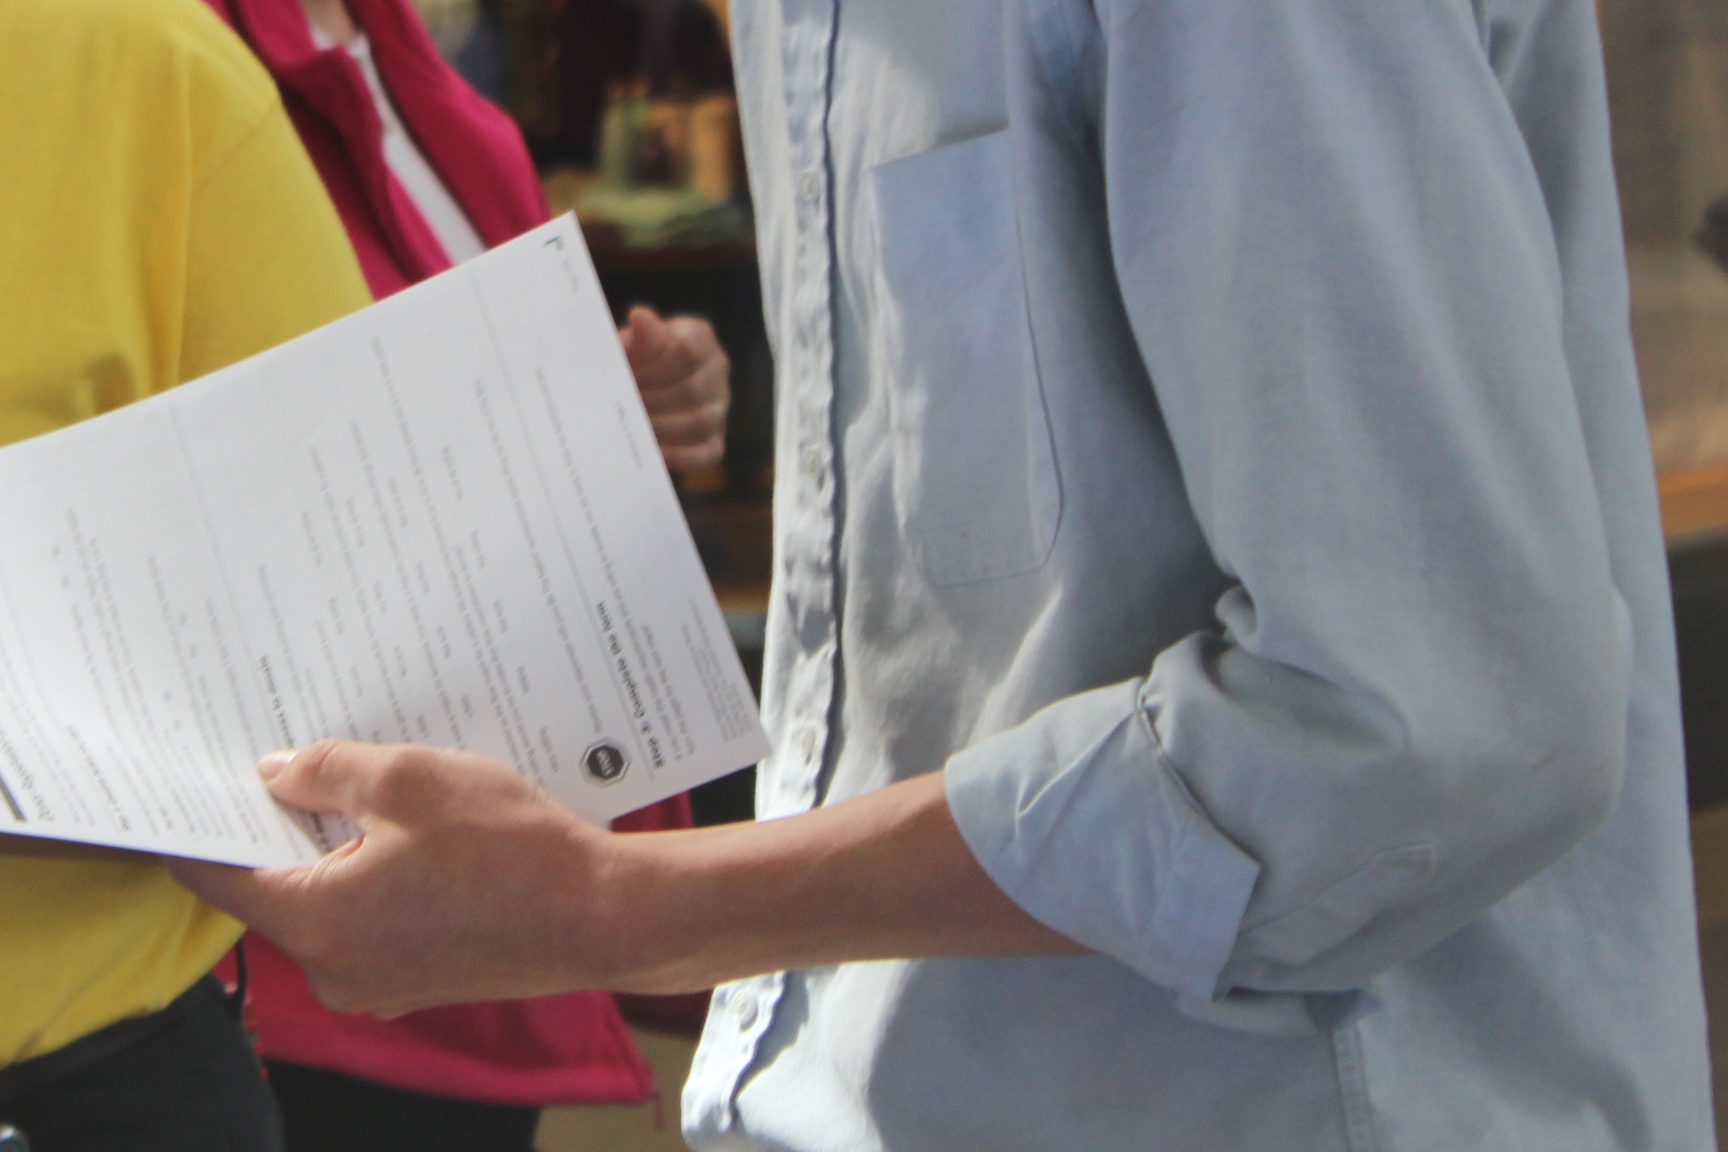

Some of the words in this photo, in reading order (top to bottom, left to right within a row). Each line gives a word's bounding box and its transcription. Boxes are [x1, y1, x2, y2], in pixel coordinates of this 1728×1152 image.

[591, 599, 616, 632] form
[604, 632, 624, 655] the
[613, 655, 649, 719] Complete
[642, 734, 668, 770] Step
